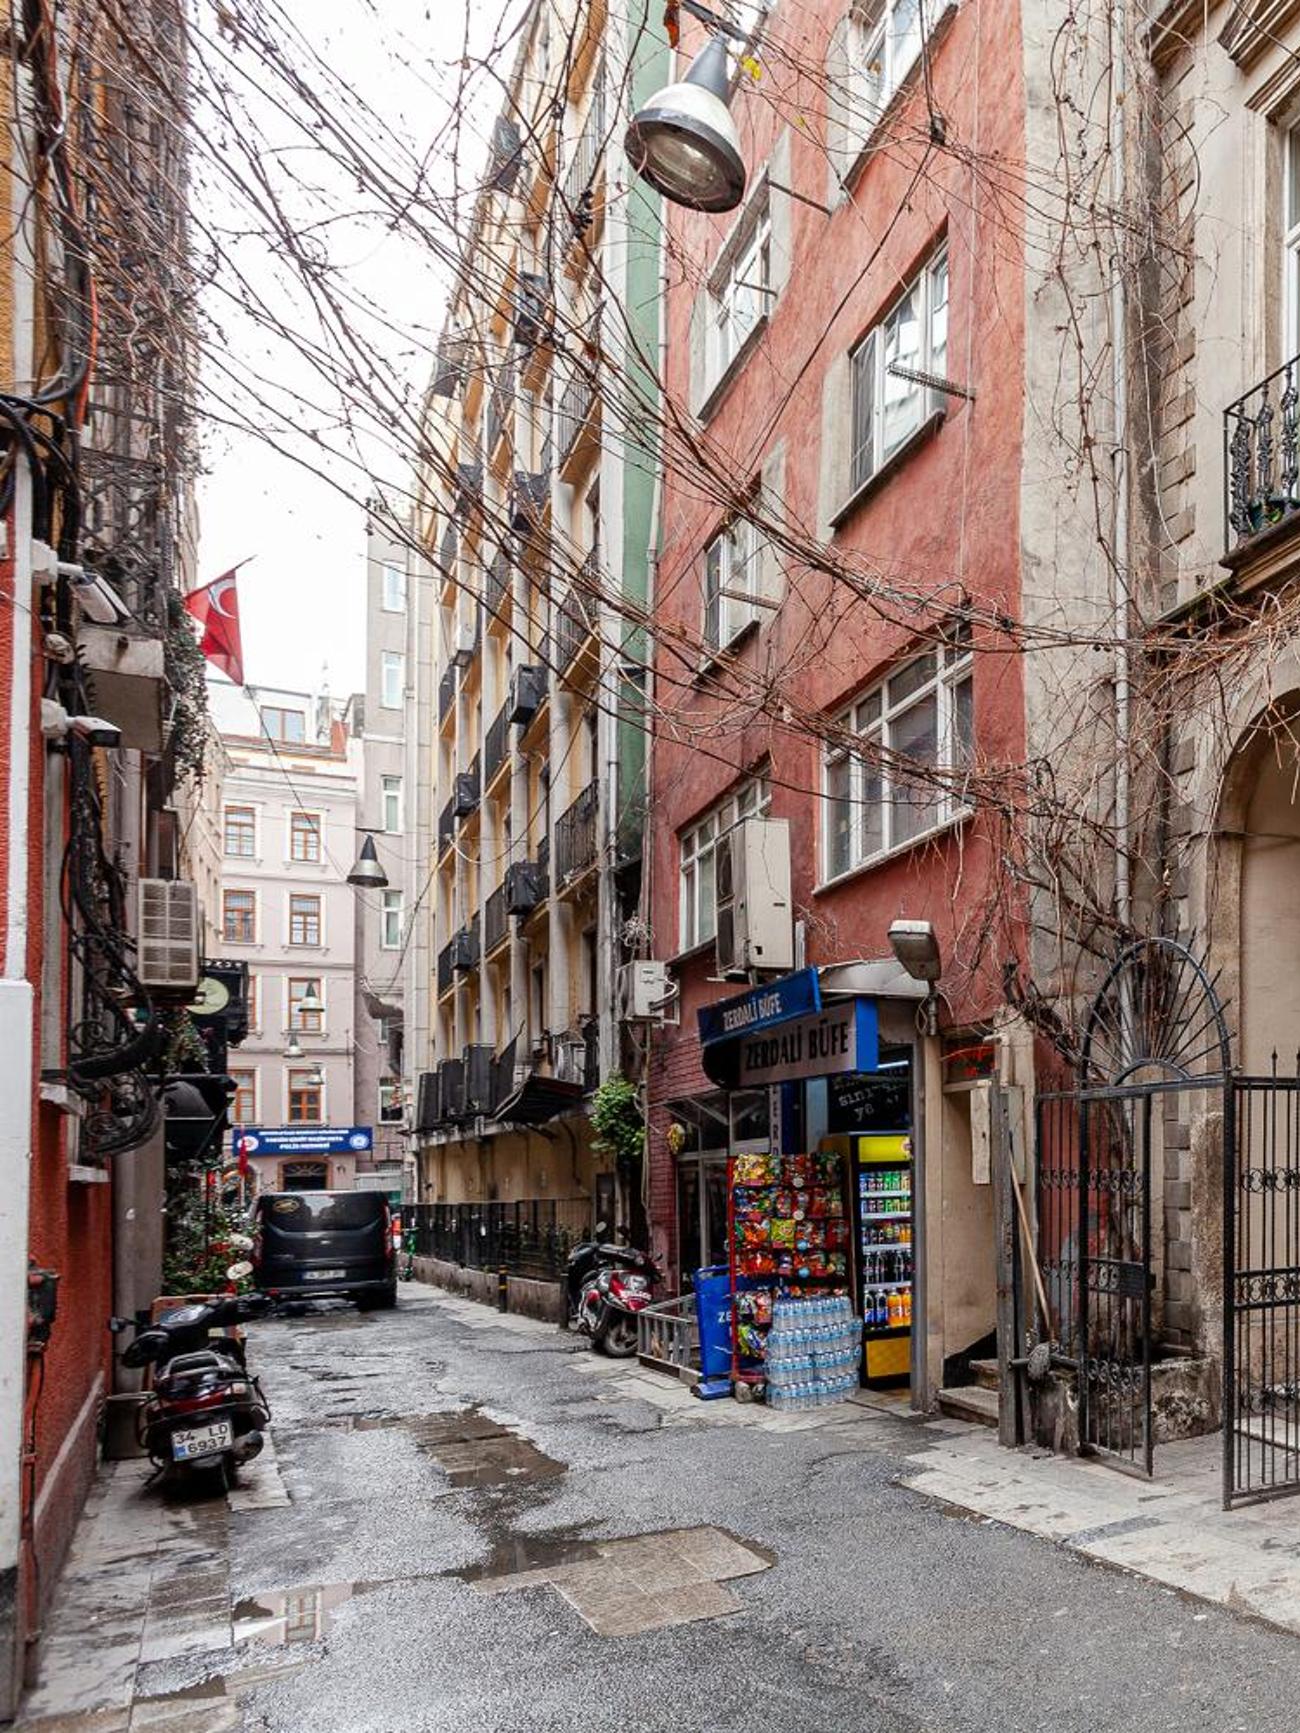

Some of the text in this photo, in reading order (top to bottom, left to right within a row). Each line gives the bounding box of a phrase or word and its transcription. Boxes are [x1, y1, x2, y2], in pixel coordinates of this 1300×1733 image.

[722, 992, 783, 1031] ZERDALİ BÜFE
[745, 1018, 849, 1071] ZERDALİ BÜFE
[175, 1424, 228, 1445] 34 LD
[187, 1436, 226, 1453] 6937
